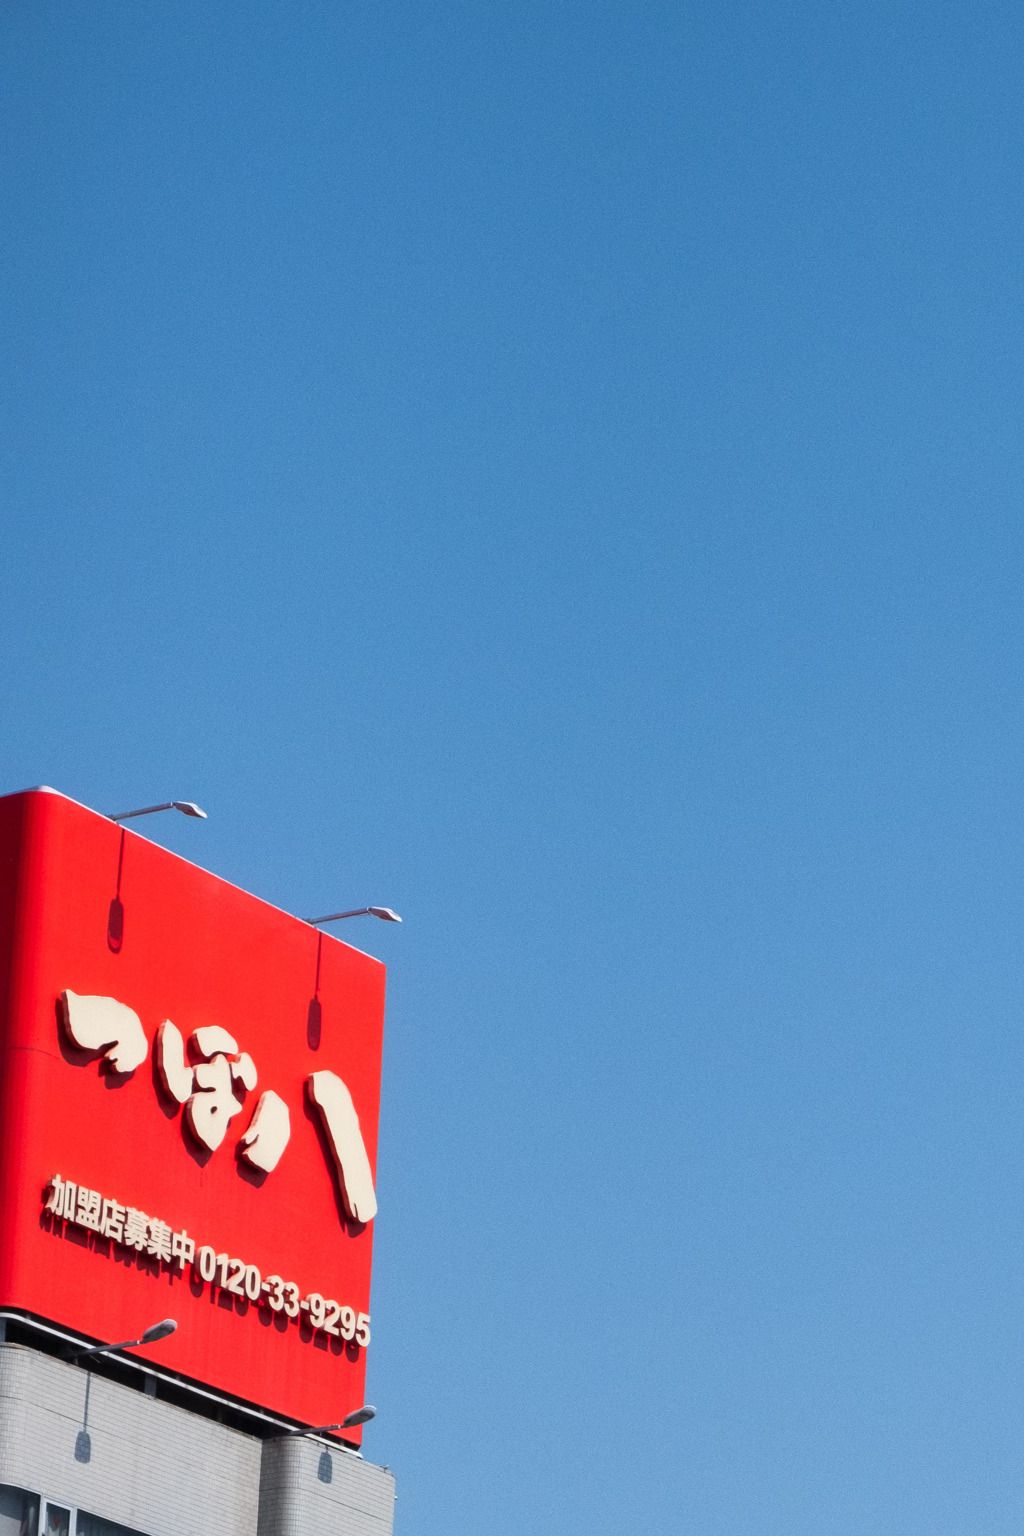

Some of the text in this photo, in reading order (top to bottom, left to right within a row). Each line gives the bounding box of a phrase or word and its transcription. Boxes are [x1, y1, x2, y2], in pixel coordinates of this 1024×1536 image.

[61, 989, 378, 1224] つぼ八
[49, 1174, 372, 1348] 加盟店募集中 0120-33-9295
